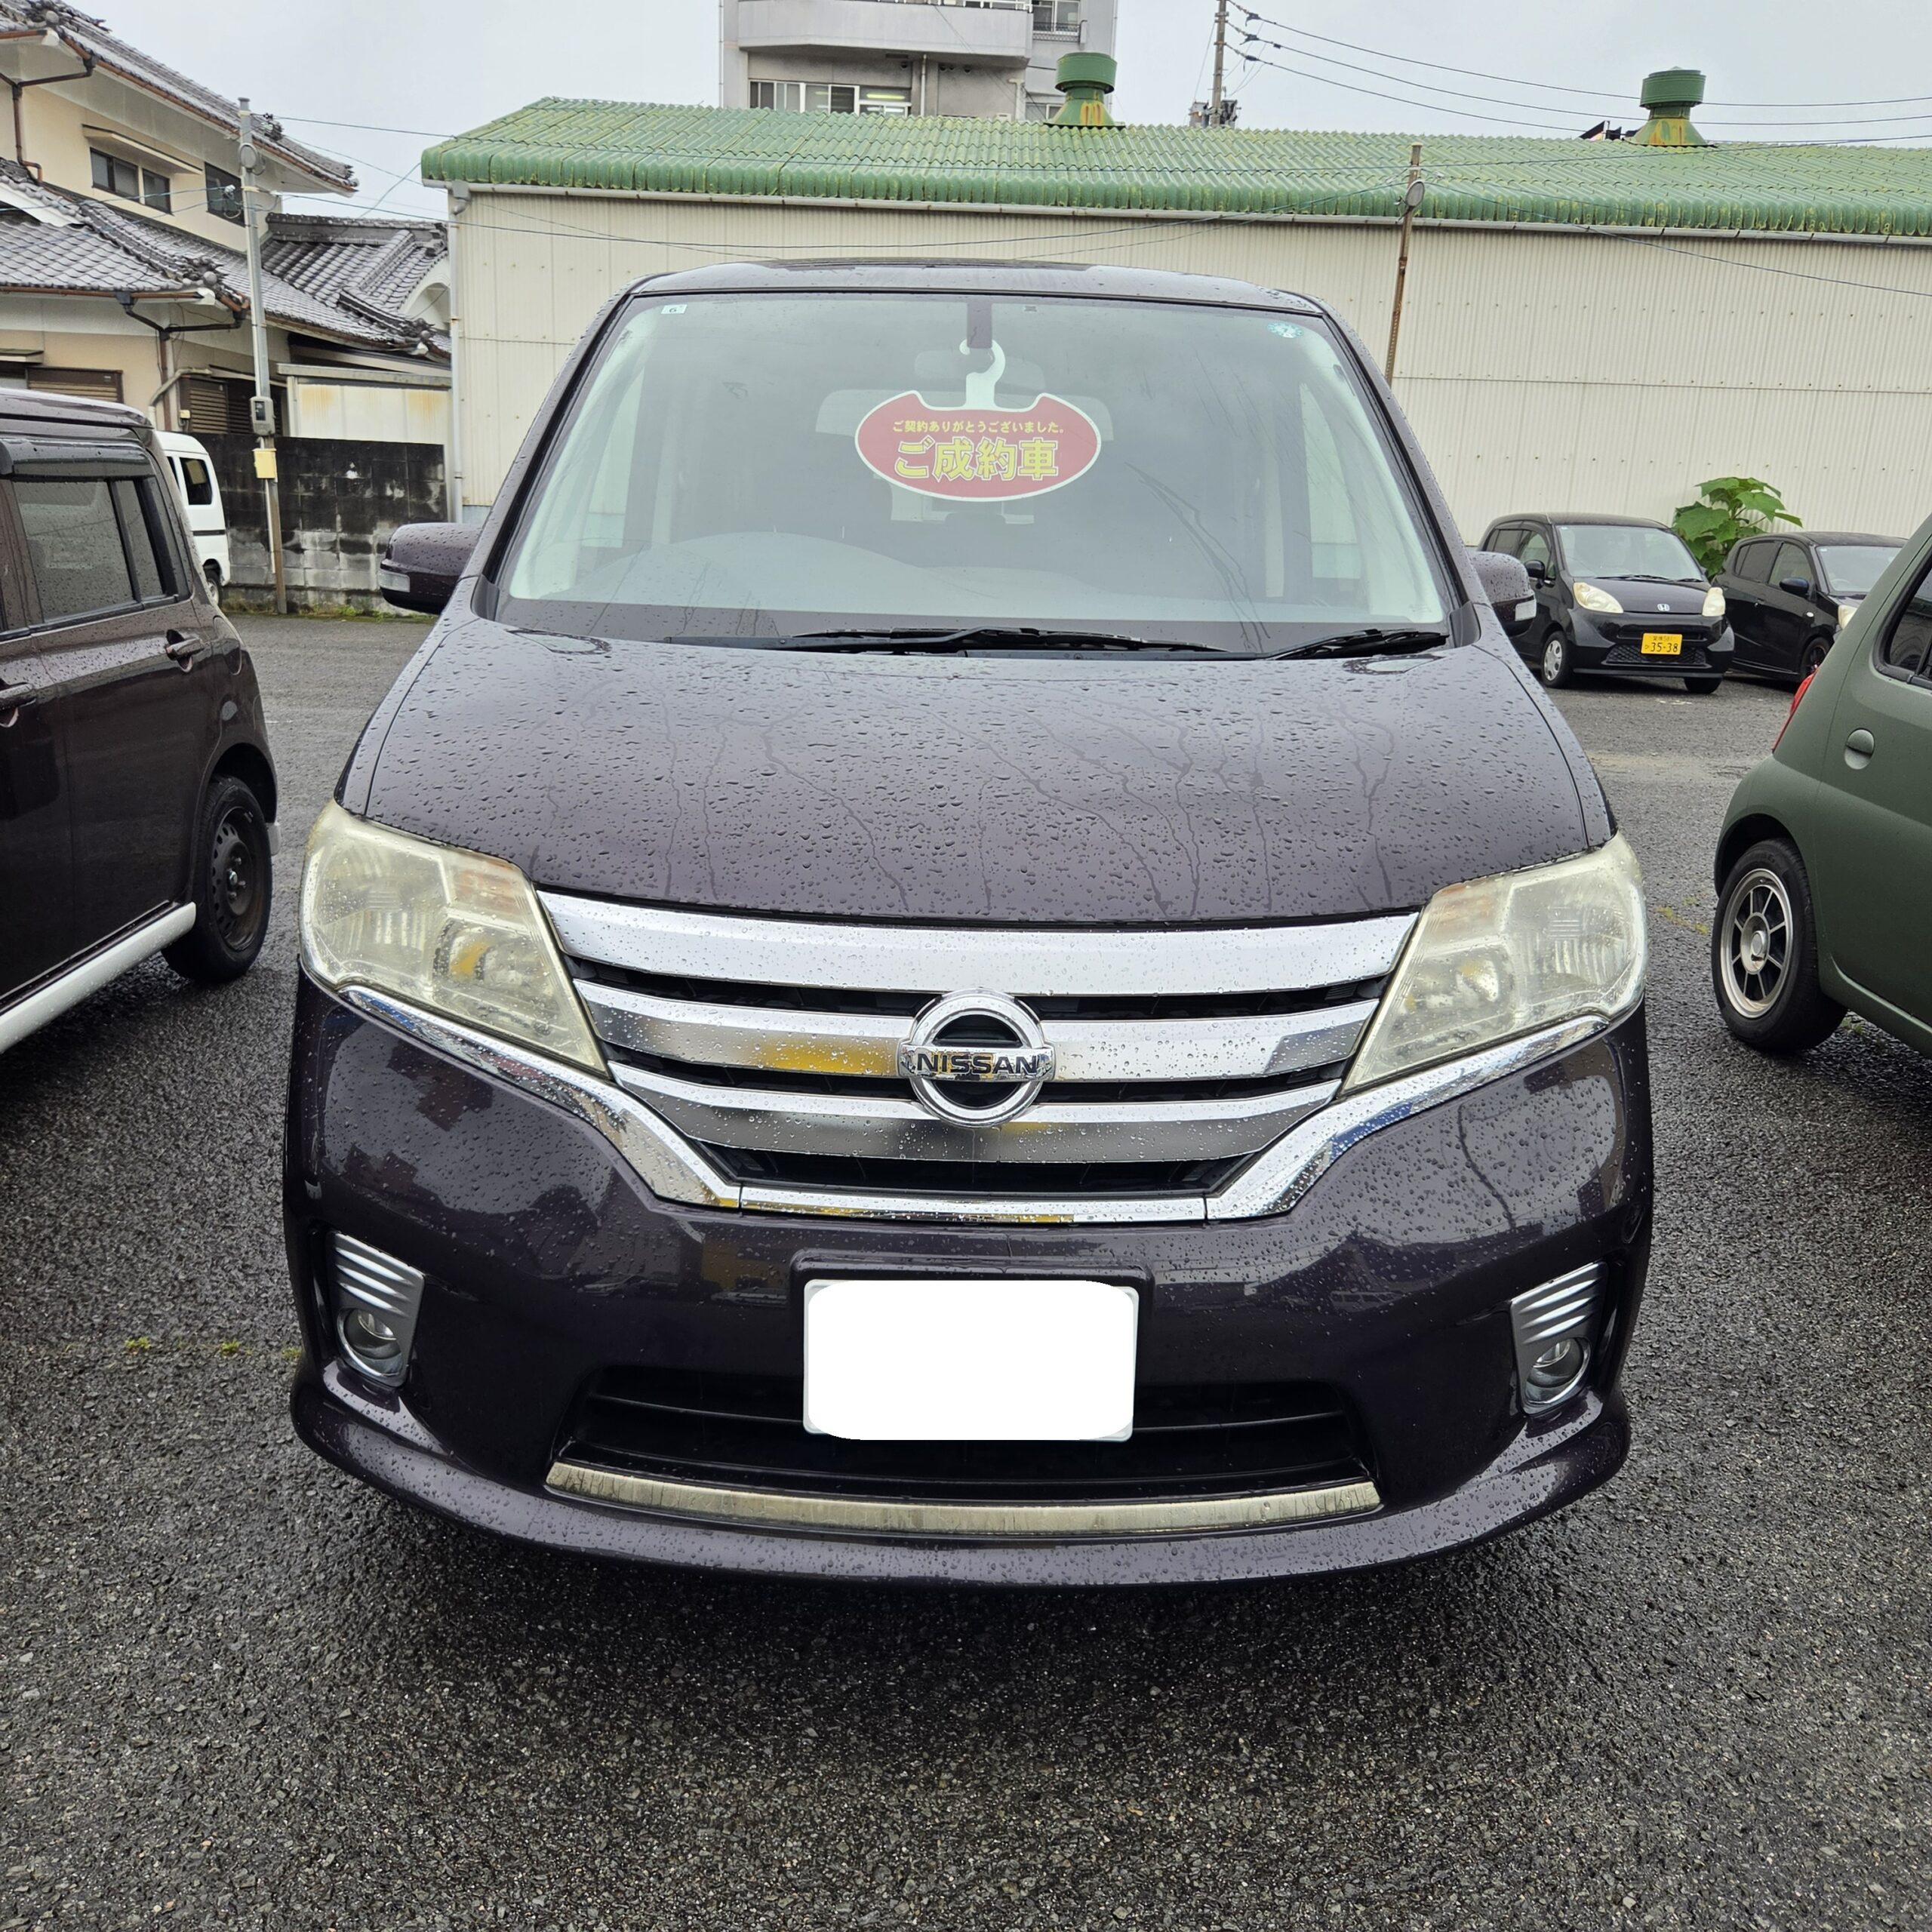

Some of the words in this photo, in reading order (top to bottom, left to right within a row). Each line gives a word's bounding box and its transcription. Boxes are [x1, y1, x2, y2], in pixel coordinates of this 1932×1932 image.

[893, 420, 1064, 434] ご契約ありがとうございました。
[894, 435, 1058, 482] ご成約車
[1650, 641, 1678, 653] 35-38
[916, 1053, 1038, 1075] NISSAN
